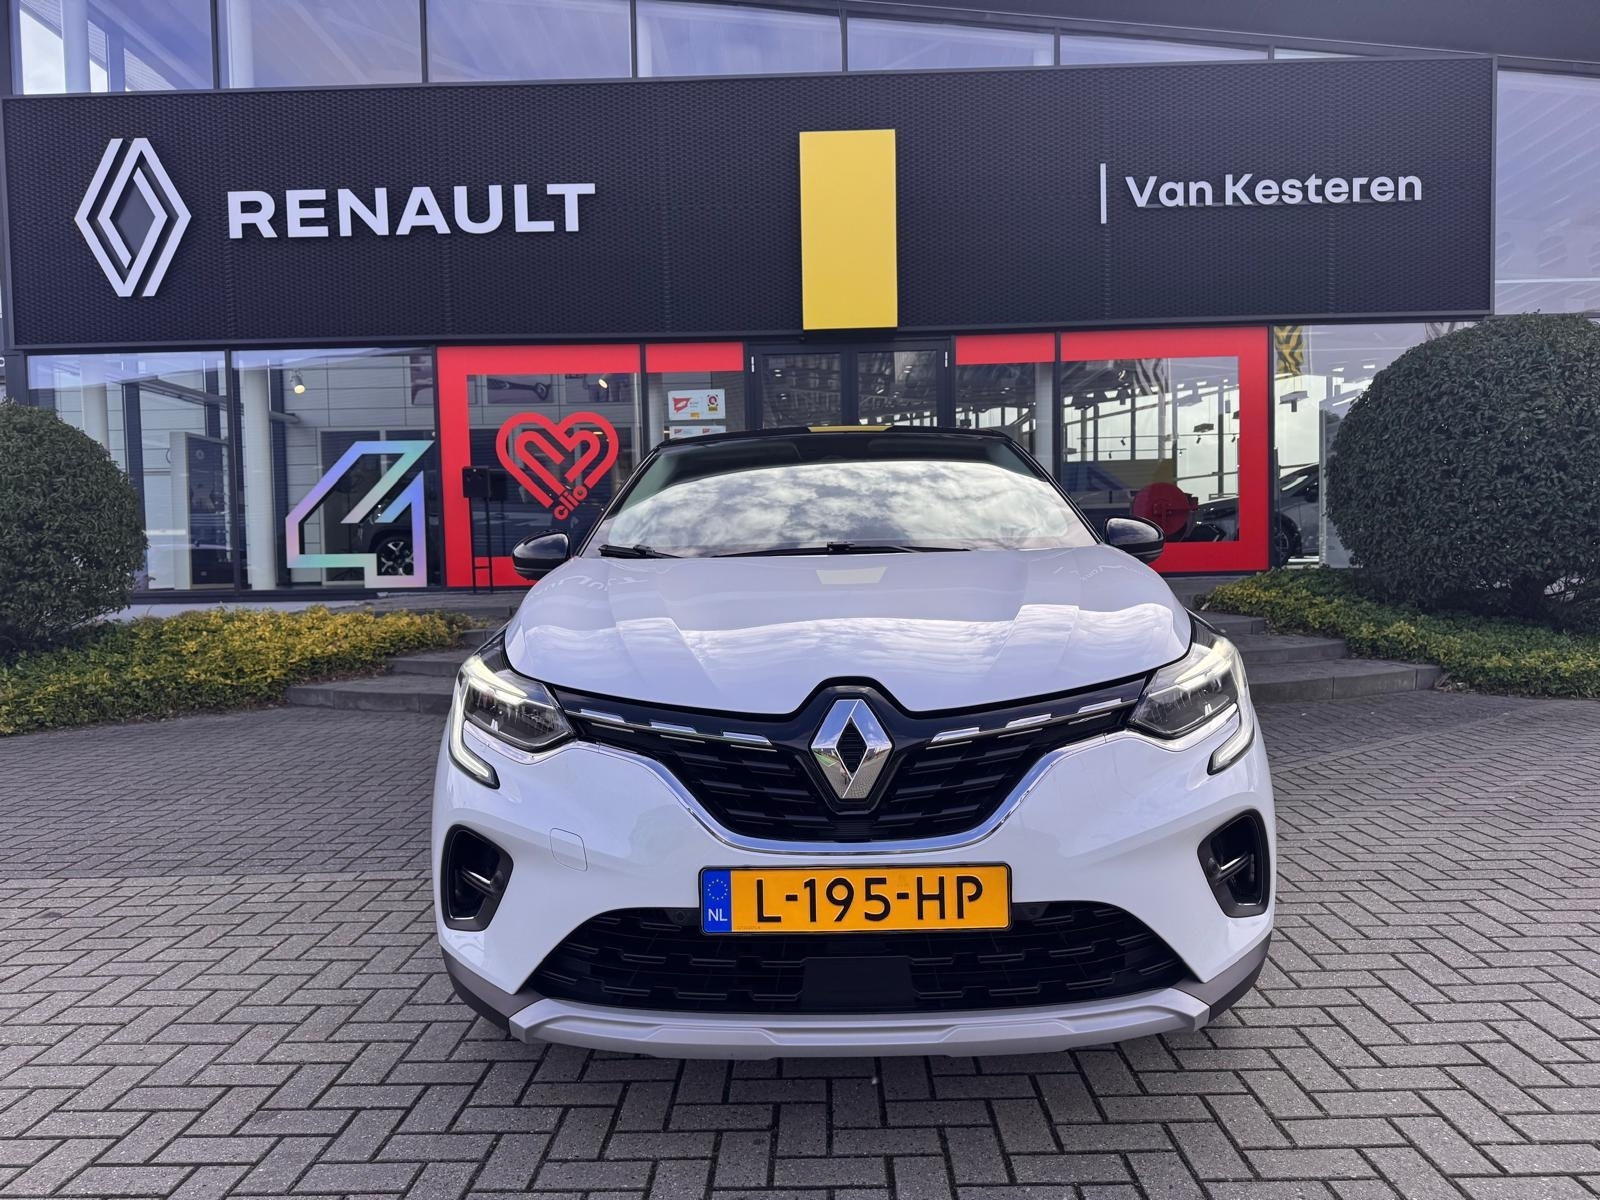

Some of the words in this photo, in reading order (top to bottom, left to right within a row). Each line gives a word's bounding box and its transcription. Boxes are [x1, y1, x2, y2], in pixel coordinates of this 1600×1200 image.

[1125, 175, 1213, 208] Van
[1225, 173, 1422, 206] Kesteren
[227, 183, 596, 239] RENAULT
[553, 485, 588, 520] clio
[708, 908, 728, 922] NL
[756, 875, 984, 923] L-195-HP
